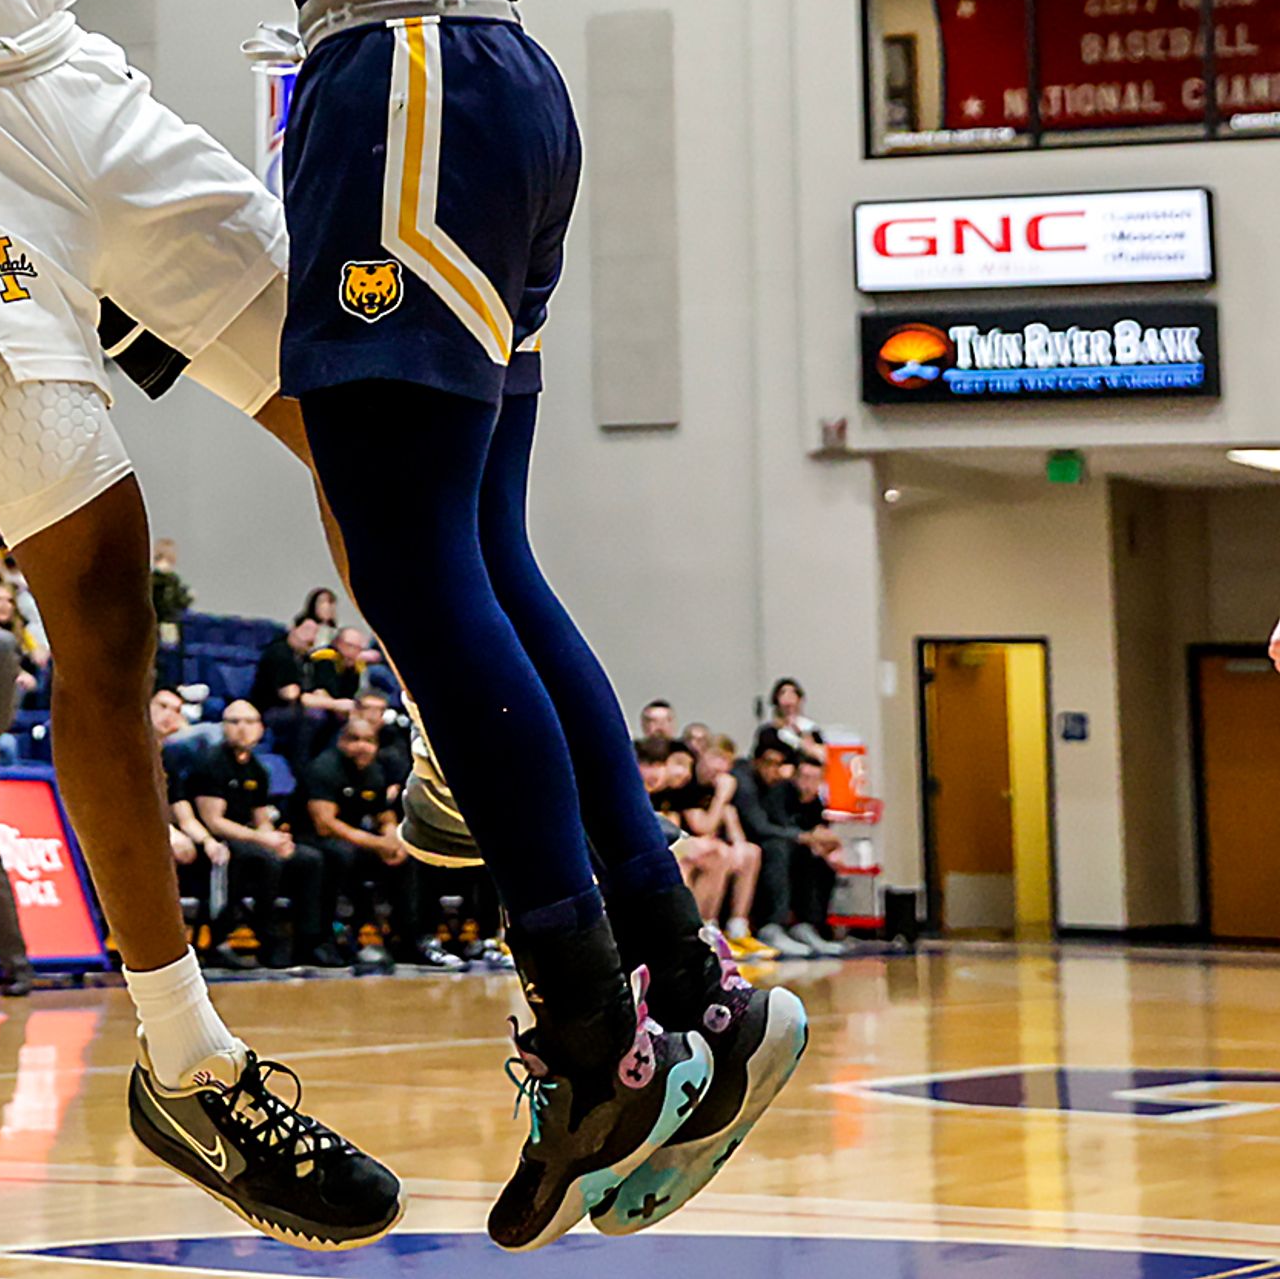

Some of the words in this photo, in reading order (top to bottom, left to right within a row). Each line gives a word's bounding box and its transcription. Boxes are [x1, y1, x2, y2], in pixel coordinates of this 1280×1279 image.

[1003, 79, 1167, 118] NTIONAL
[872, 210, 1087, 258] GNC
[948, 325, 1023, 370] TWIN
[1023, 322, 1114, 367] RIVER
[1113, 319, 1203, 365] BANK
